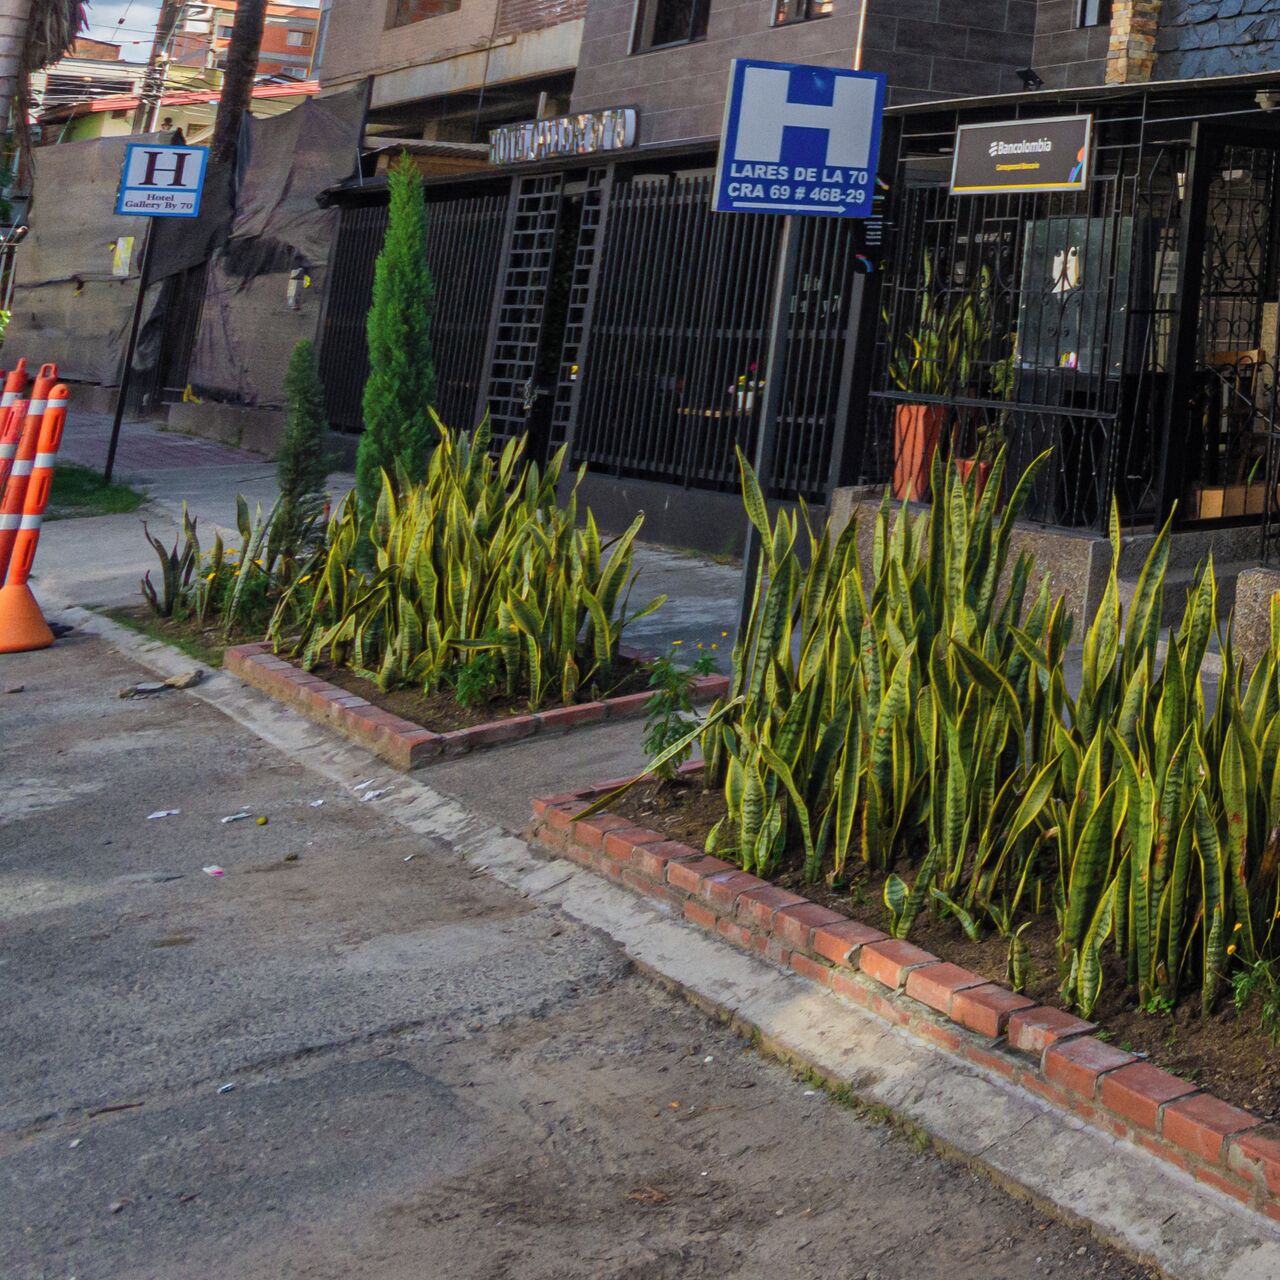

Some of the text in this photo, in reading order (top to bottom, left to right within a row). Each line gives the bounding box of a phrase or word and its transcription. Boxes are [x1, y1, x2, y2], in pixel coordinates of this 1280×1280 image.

[734, 67, 878, 169] H
[997, 137, 1052, 155] Bancolombia
[137, 150, 192, 187] H
[730, 163, 868, 185] LARES DE LA 70
[727, 182, 866, 204] CRA 69 # 46B-29
[125, 200, 193, 211] Gallery By 70
